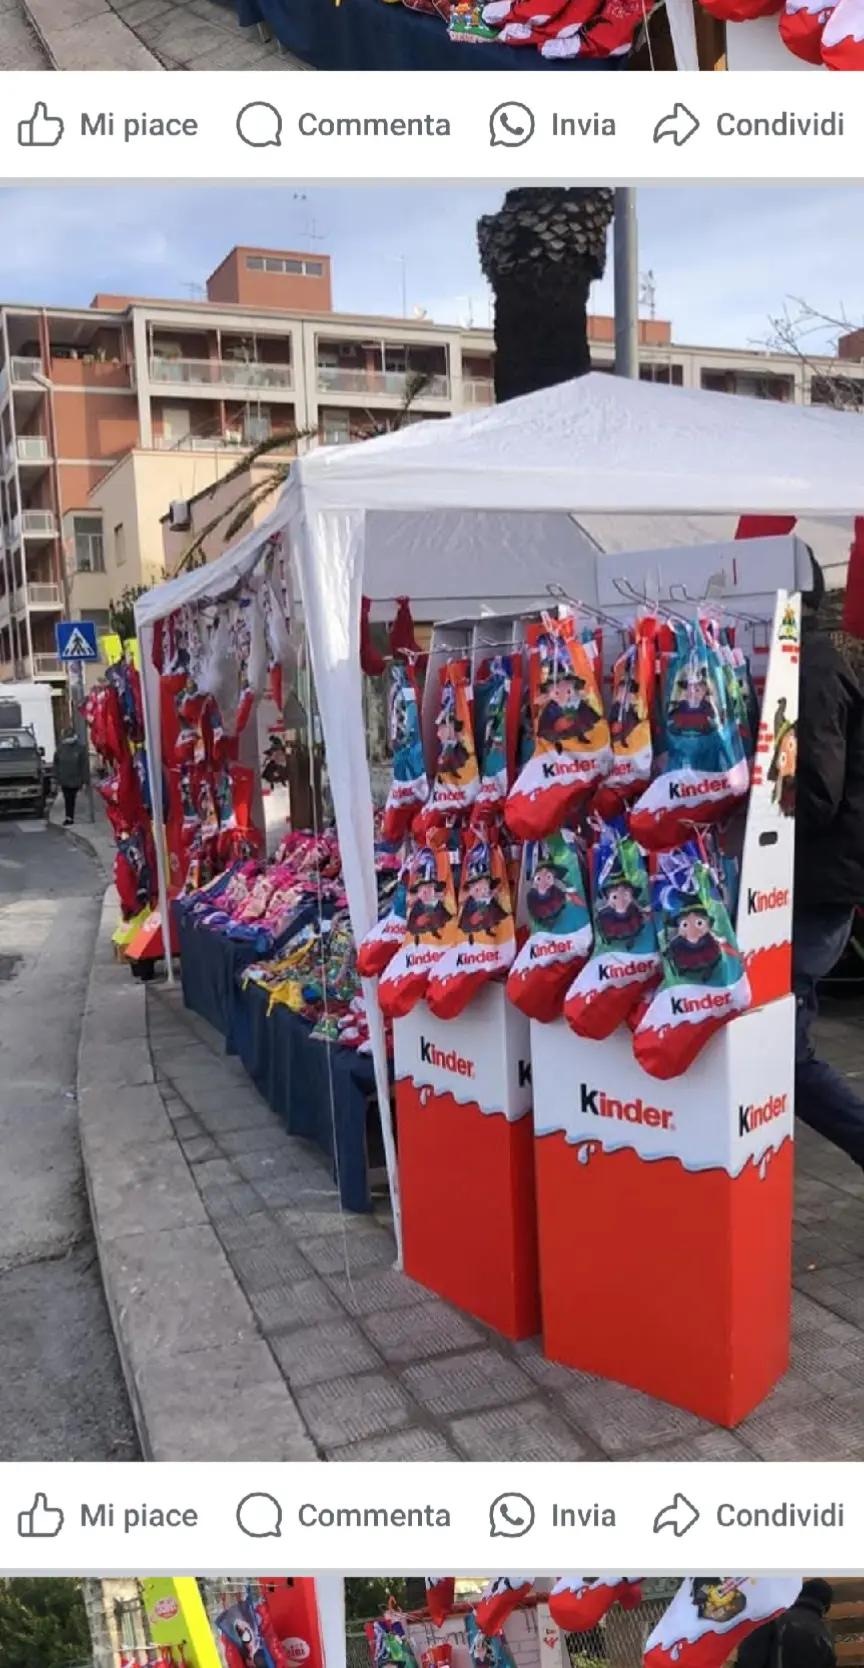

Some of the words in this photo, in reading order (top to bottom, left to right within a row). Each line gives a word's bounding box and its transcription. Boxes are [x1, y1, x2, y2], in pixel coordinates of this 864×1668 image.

[542, 758, 597, 779] Kinder
[669, 777, 728, 800] Kinder
[747, 886, 789, 916] Kinder
[529, 938, 573, 961] Kinder
[598, 959, 655, 981] Kinder
[670, 991, 732, 1015] Kinder
[419, 1035, 475, 1079] Kinder
[579, 1083, 674, 1131] Kinder
[738, 1092, 788, 1138] Kinder
